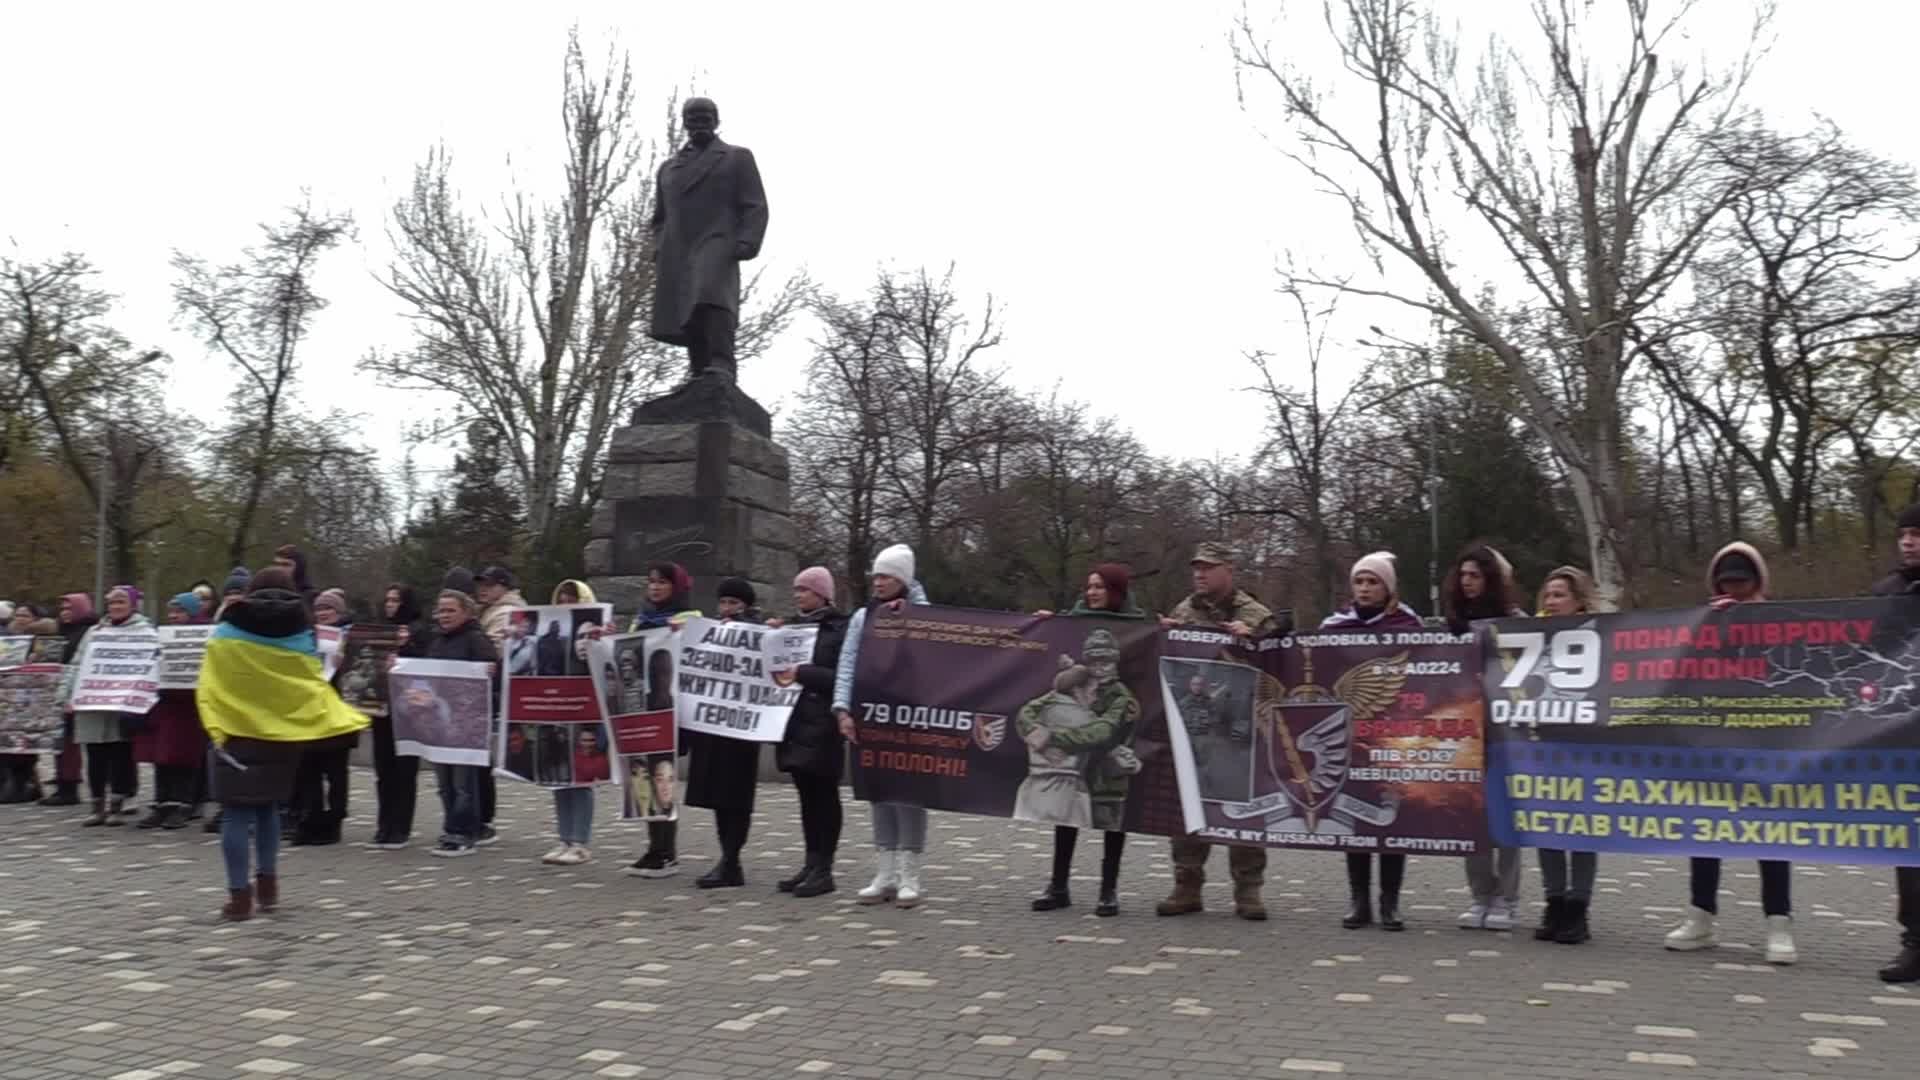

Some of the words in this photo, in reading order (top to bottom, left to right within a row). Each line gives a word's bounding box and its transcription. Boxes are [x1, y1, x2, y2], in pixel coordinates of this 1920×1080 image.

[1296, 633, 1379, 647] ЧОЛОВІКА
[1382, 633, 1394, 645] З
[1613, 624, 1721, 650] ПОНАД
[1728, 619, 1873, 646] ПІВРОКУ
[1496, 629, 1601, 689] 79
[861, 703, 891, 723] 79
[895, 705, 974, 731] ОДШБ
[1491, 699, 1598, 727] ОДШБ
[860, 750, 875, 768] В
[1592, 778, 1825, 812] ЗАХИЩАЛИ
[1266, 832, 1337, 847] HUSBAND
[1338, 835, 1378, 848] FROM
[1617, 815, 1684, 840] ЧАС
[1692, 818, 1908, 849] ЗАХИСТИТИ
